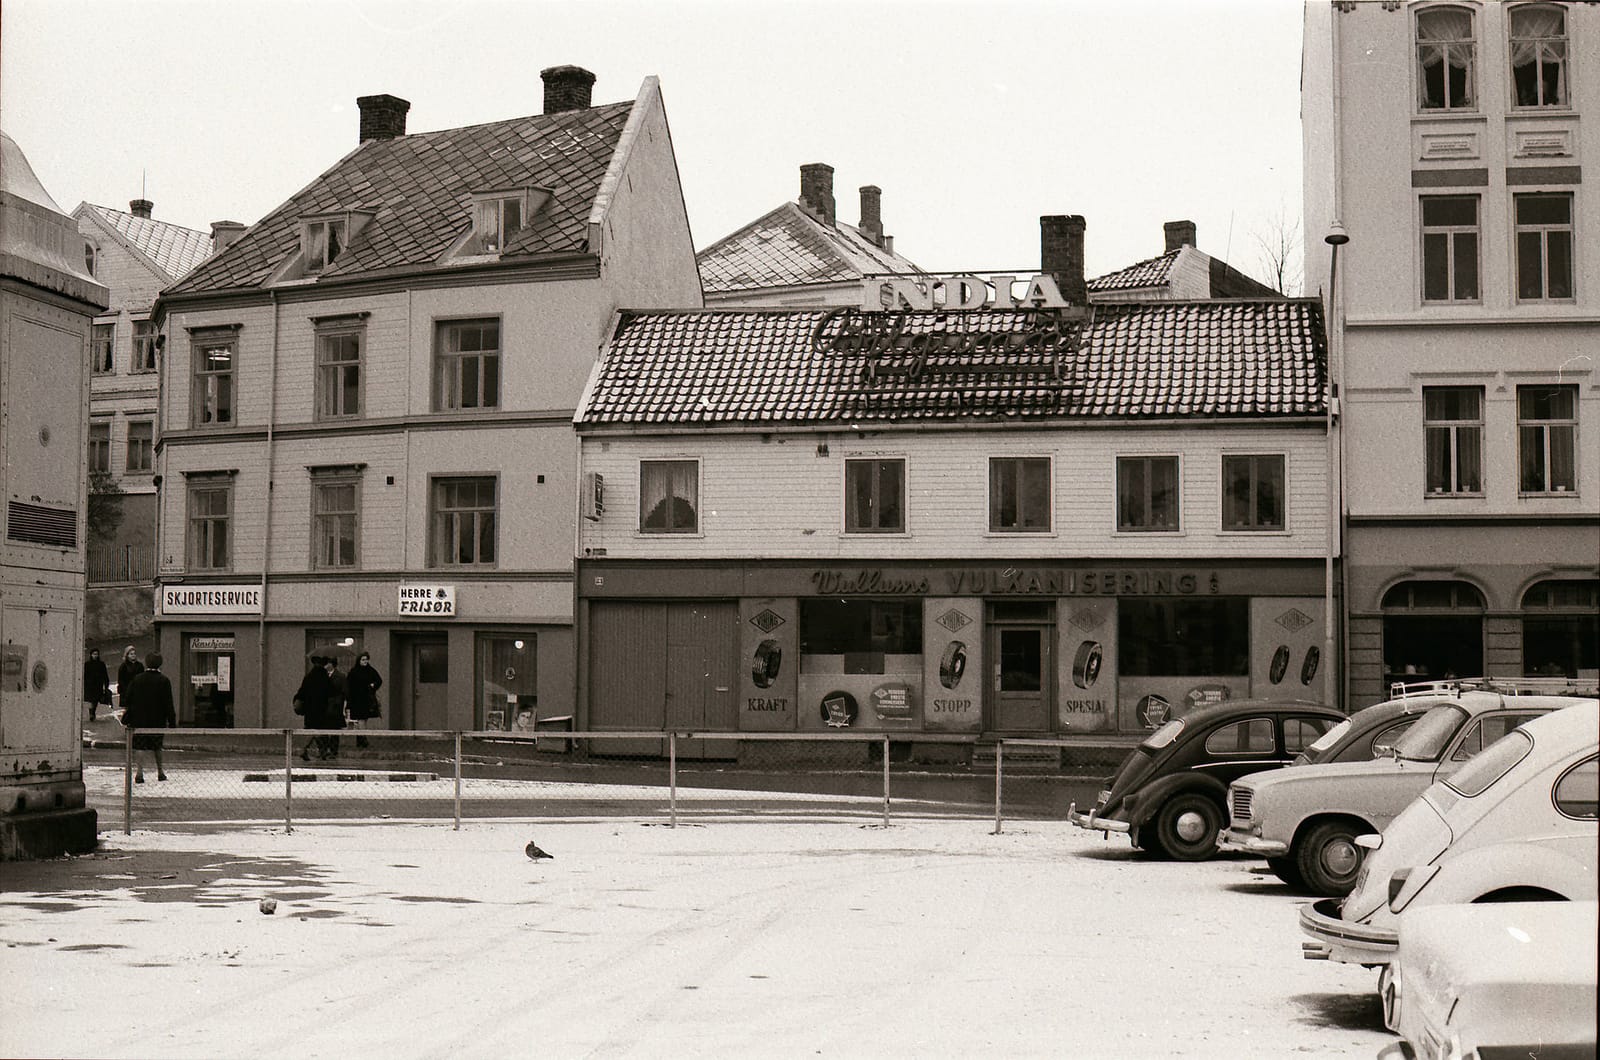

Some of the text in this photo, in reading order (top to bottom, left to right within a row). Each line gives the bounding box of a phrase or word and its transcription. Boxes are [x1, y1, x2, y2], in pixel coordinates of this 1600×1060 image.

[860, 274, 1070, 312] INDIA
[811, 570, 929, 594] Wullums
[944, 570, 1197, 594] VULKANISERING
[167, 591, 259, 606] SKJORTESERVICE
[400, 588, 432, 599] HERRE
[400, 600, 452, 613] FRISØR
[748, 698, 788, 711] KRAFT
[933, 699, 971, 712] STOPP
